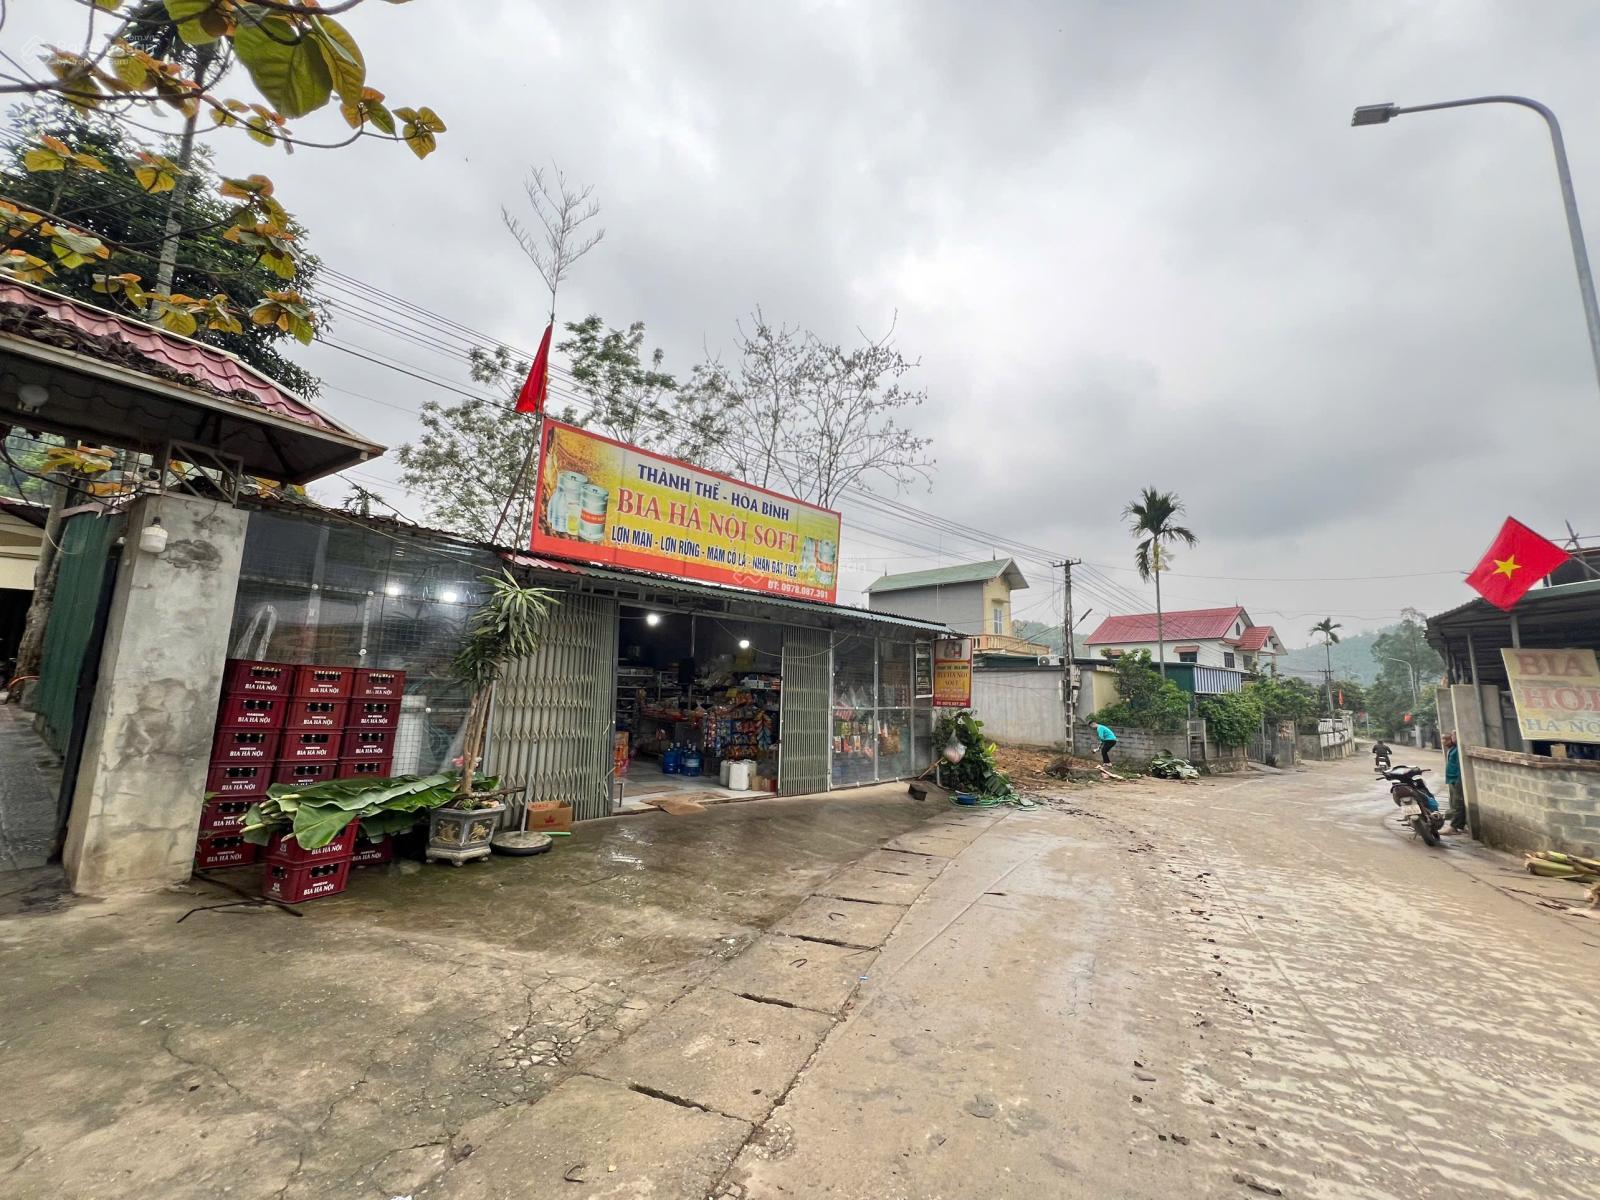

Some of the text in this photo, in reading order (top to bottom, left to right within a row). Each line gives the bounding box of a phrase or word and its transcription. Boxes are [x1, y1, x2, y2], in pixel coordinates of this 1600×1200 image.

[638, 463, 690, 492] THÀNH
[616, 487, 661, 521] BIA
[667, 502, 702, 531] HÀ
[708, 512, 748, 543] NỘI
[753, 524, 799, 553] SOFT
[612, 525, 630, 545] LỢN
[660, 535, 677, 554] LỢN
[1516, 653, 1593, 677] BIA
[303, 888, 313, 896] BIA
